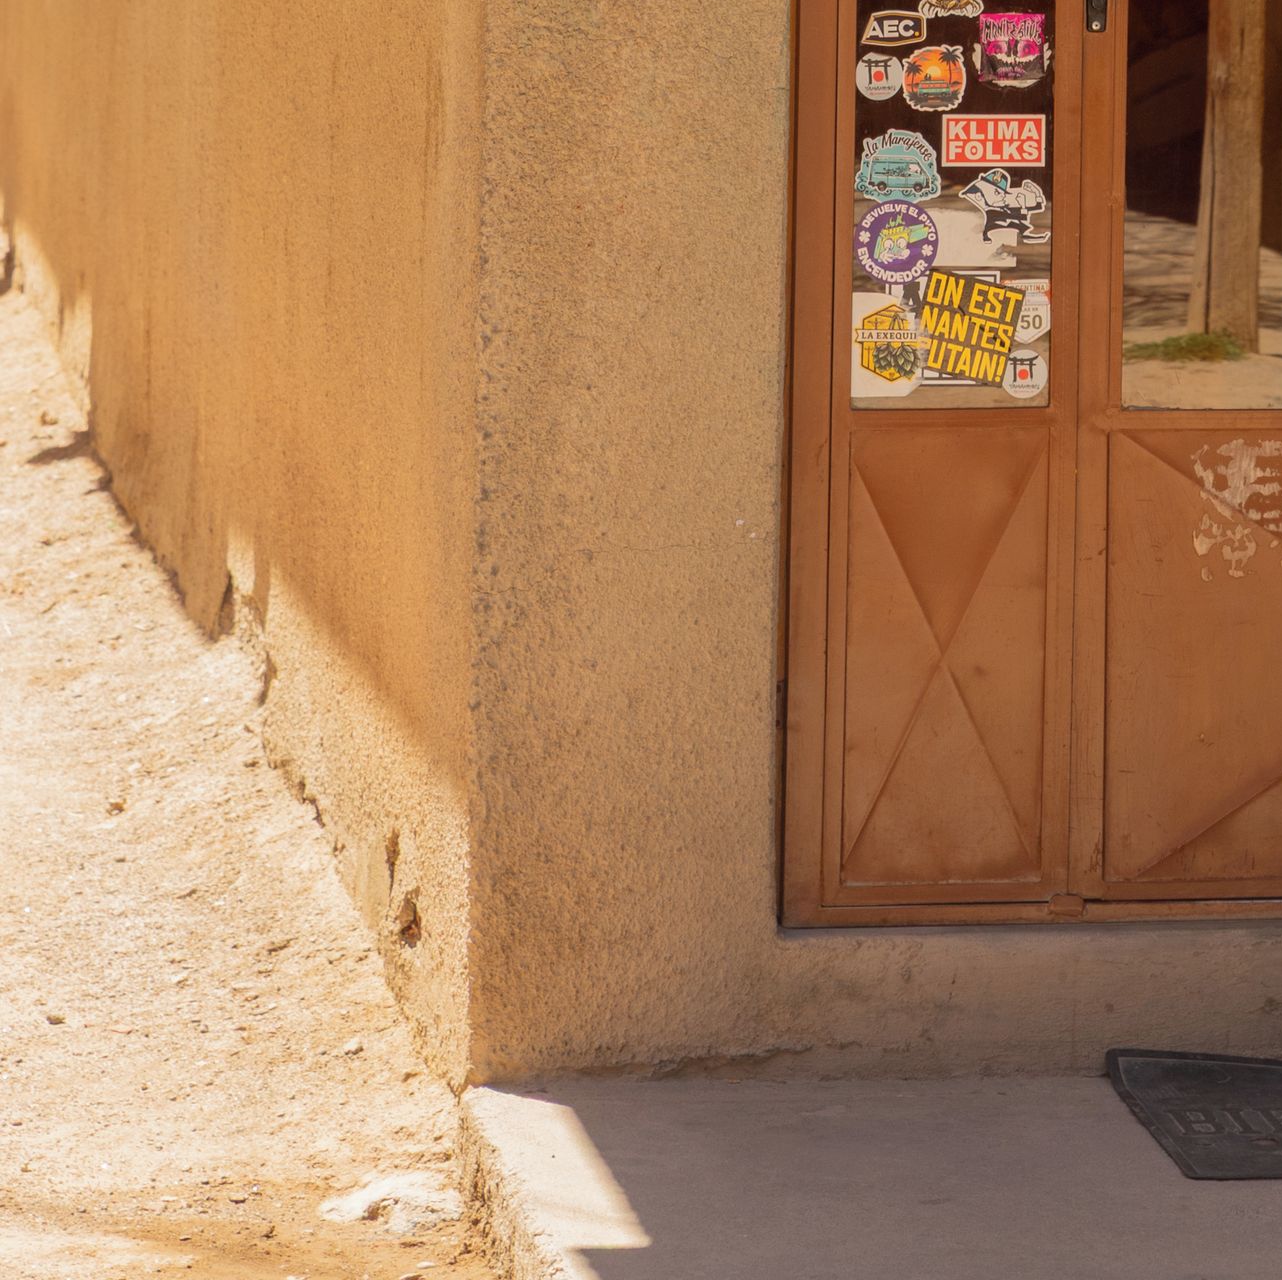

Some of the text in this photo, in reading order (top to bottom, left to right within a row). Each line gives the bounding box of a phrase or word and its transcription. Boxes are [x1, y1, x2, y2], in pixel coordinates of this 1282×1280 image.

[949, 120, 1039, 140] KLIMA
[865, 141, 878, 159] La
[949, 141, 1039, 160] FOLKS
[862, 204, 908, 228] DEVUELVE
[908, 206, 919, 218] EL
[857, 246, 928, 282] ENCENDEDOR
[926, 272, 1023, 323] ON EST
[921, 304, 1014, 353] NANTES
[1021, 314, 1042, 330] 50
[862, 330, 874, 339] LA
[927, 339, 1006, 383] UTAIN!
